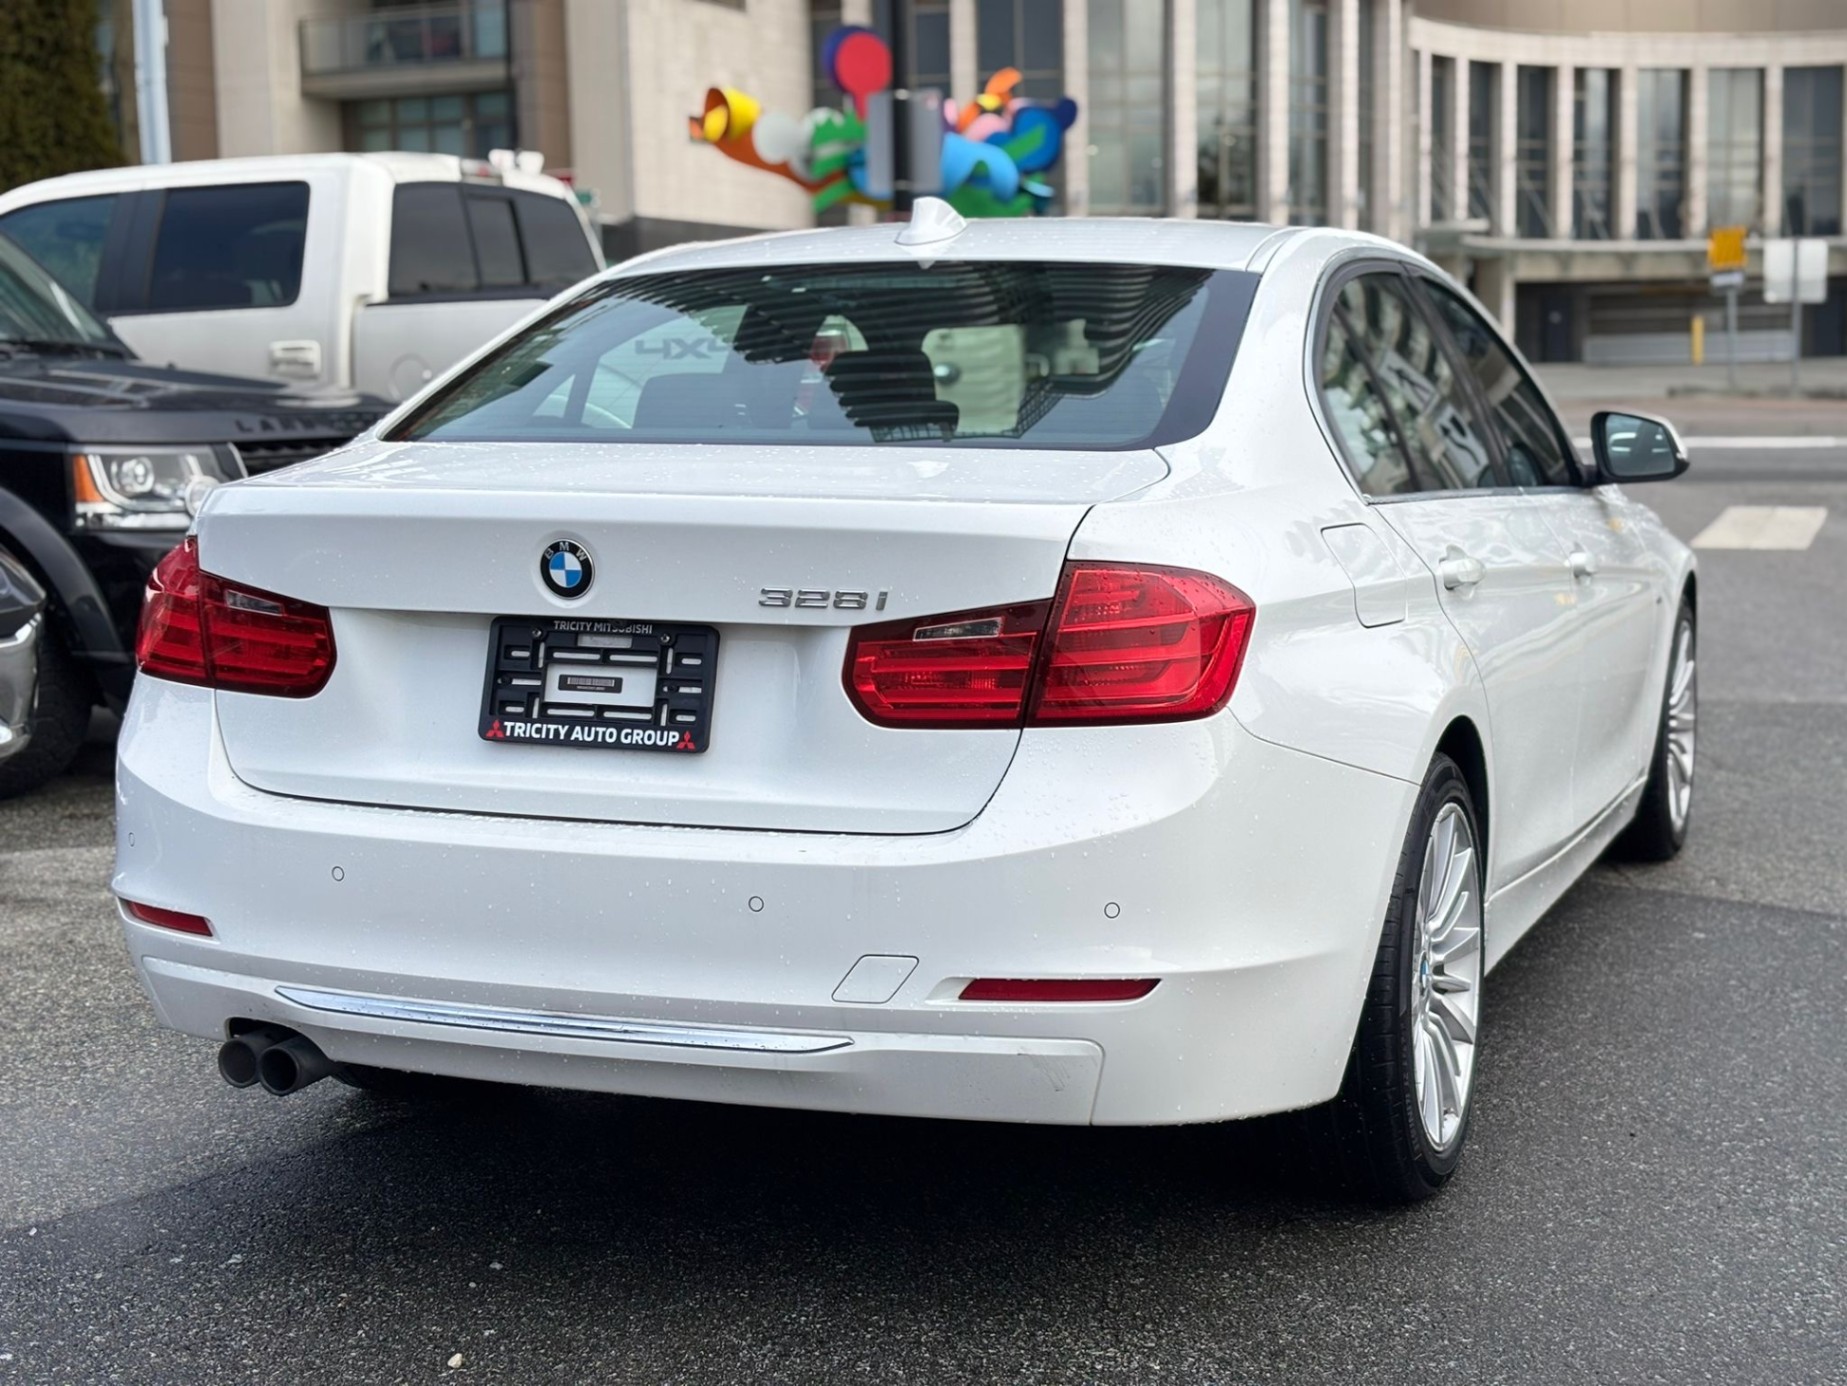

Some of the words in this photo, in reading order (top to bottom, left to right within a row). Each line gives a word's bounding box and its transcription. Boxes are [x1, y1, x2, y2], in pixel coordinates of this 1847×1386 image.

[544, 541, 587, 561] BMW
[758, 587, 888, 611] 328i
[554, 620, 592, 632] TRICITY
[503, 721, 569, 739] TRICITY
[570, 725, 617, 743] AUTO
[621, 728, 680, 747] GROUP
